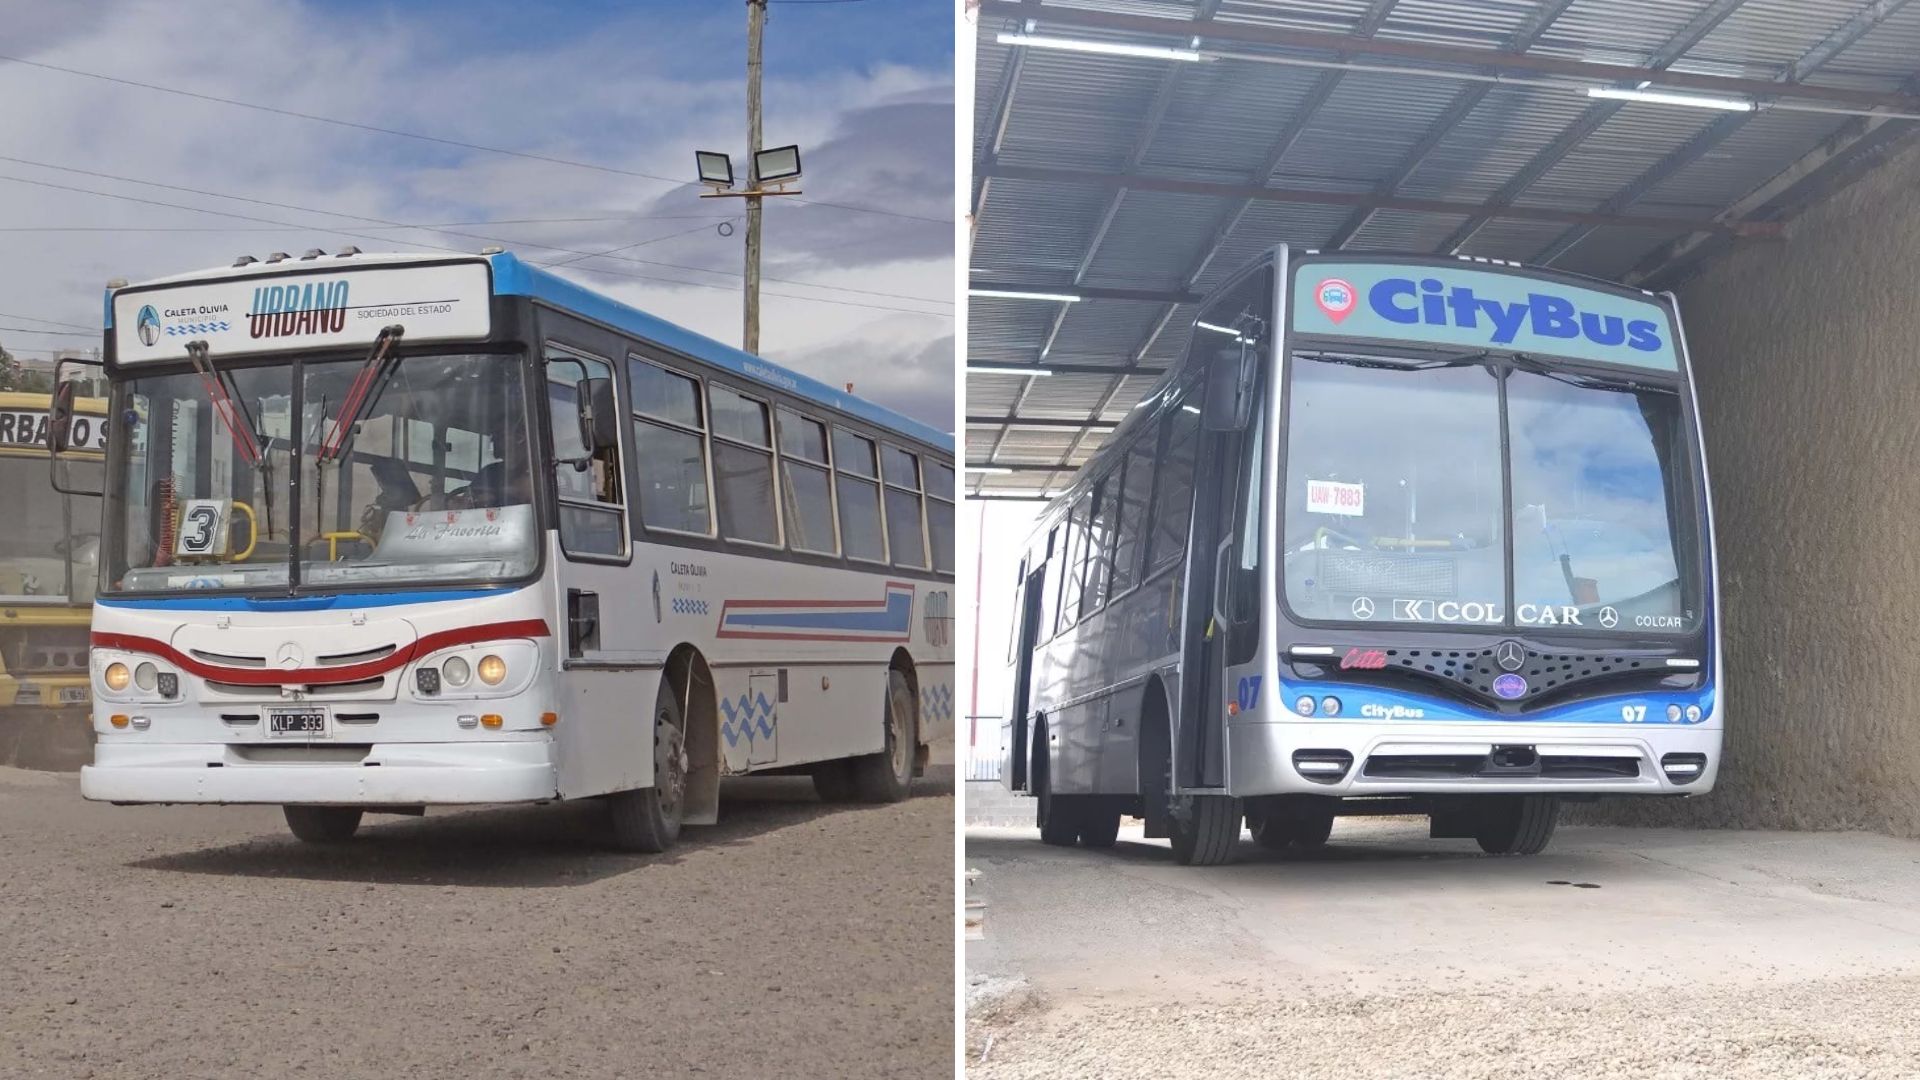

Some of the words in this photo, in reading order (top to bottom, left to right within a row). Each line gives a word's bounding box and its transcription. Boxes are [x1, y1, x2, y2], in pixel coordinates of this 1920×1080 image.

[164, 307, 197, 318] CALETA
[199, 304, 229, 314] OLIVIA
[250, 280, 349, 339] URBANO
[357, 308, 399, 319] SOCIEDAD
[401, 307, 416, 316] DEL
[418, 304, 452, 315] ESTADO
[1368, 278, 1663, 352] CityBus
[0, 413, 90, 447] RBAO
[183, 506, 219, 552] 3
[434, 521, 502, 541] Favorita
[671, 561, 690, 576] CALETA
[1635, 615, 1682, 628] COLCAR
[1238, 675, 1263, 711] 07
[1361, 703, 1425, 721] CityBus
[1622, 704, 1647, 723] 07
[272, 715, 294, 731] KLP
[300, 715, 323, 730] 333
